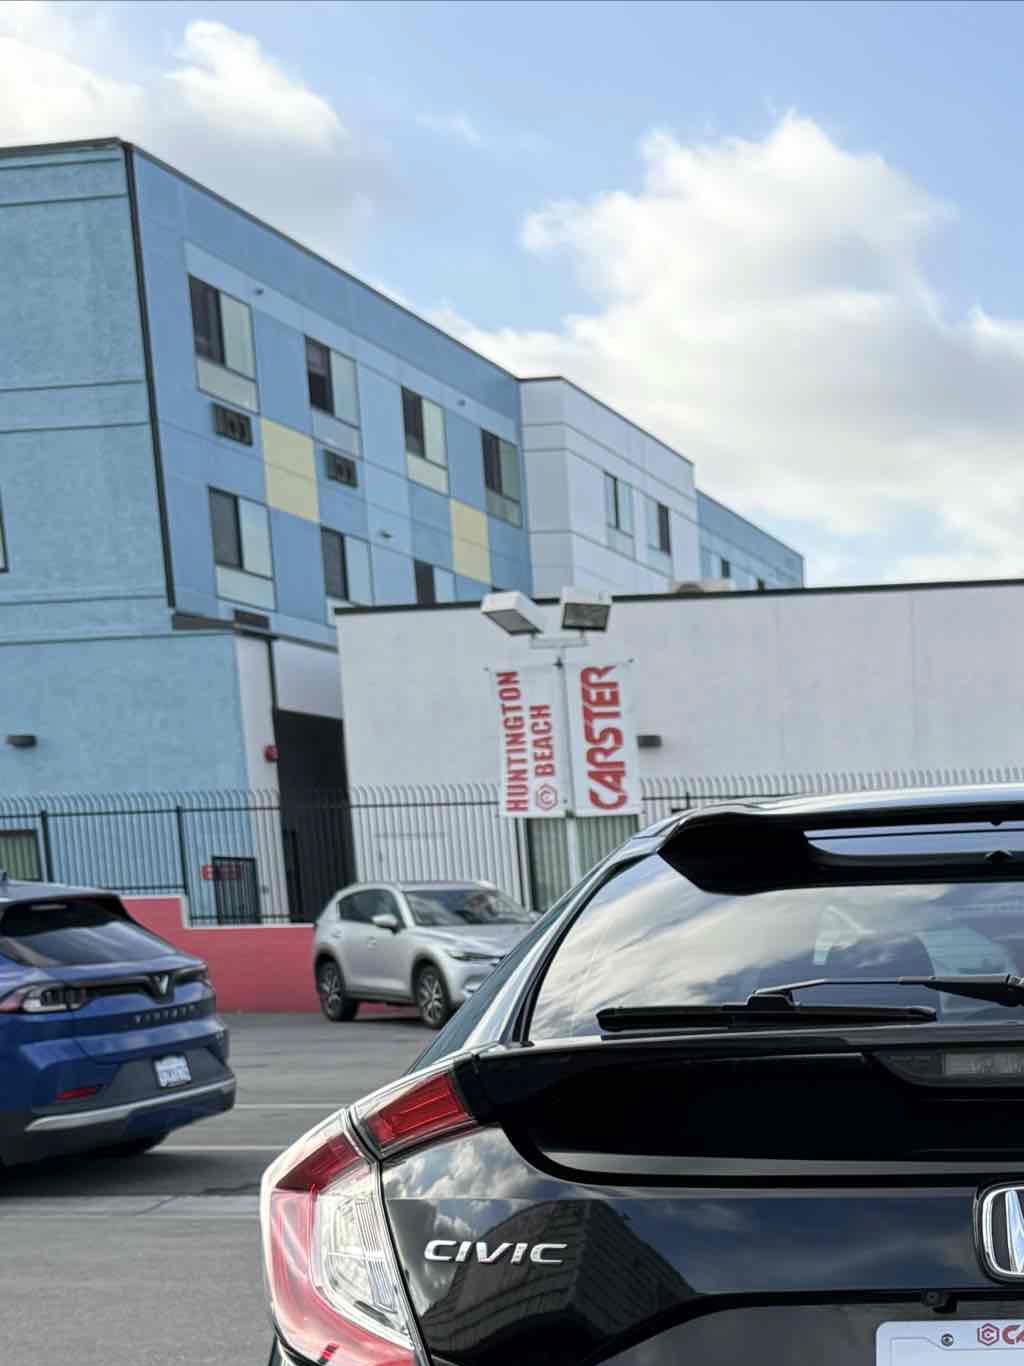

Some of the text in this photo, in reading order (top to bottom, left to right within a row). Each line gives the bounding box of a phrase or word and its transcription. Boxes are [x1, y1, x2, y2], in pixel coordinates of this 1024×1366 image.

[496, 671, 529, 812] HUNTINGTON
[529, 703, 556, 779] BEACH
[580, 665, 628, 811] CARSTER
[424, 1239, 568, 1263] CIVIC
